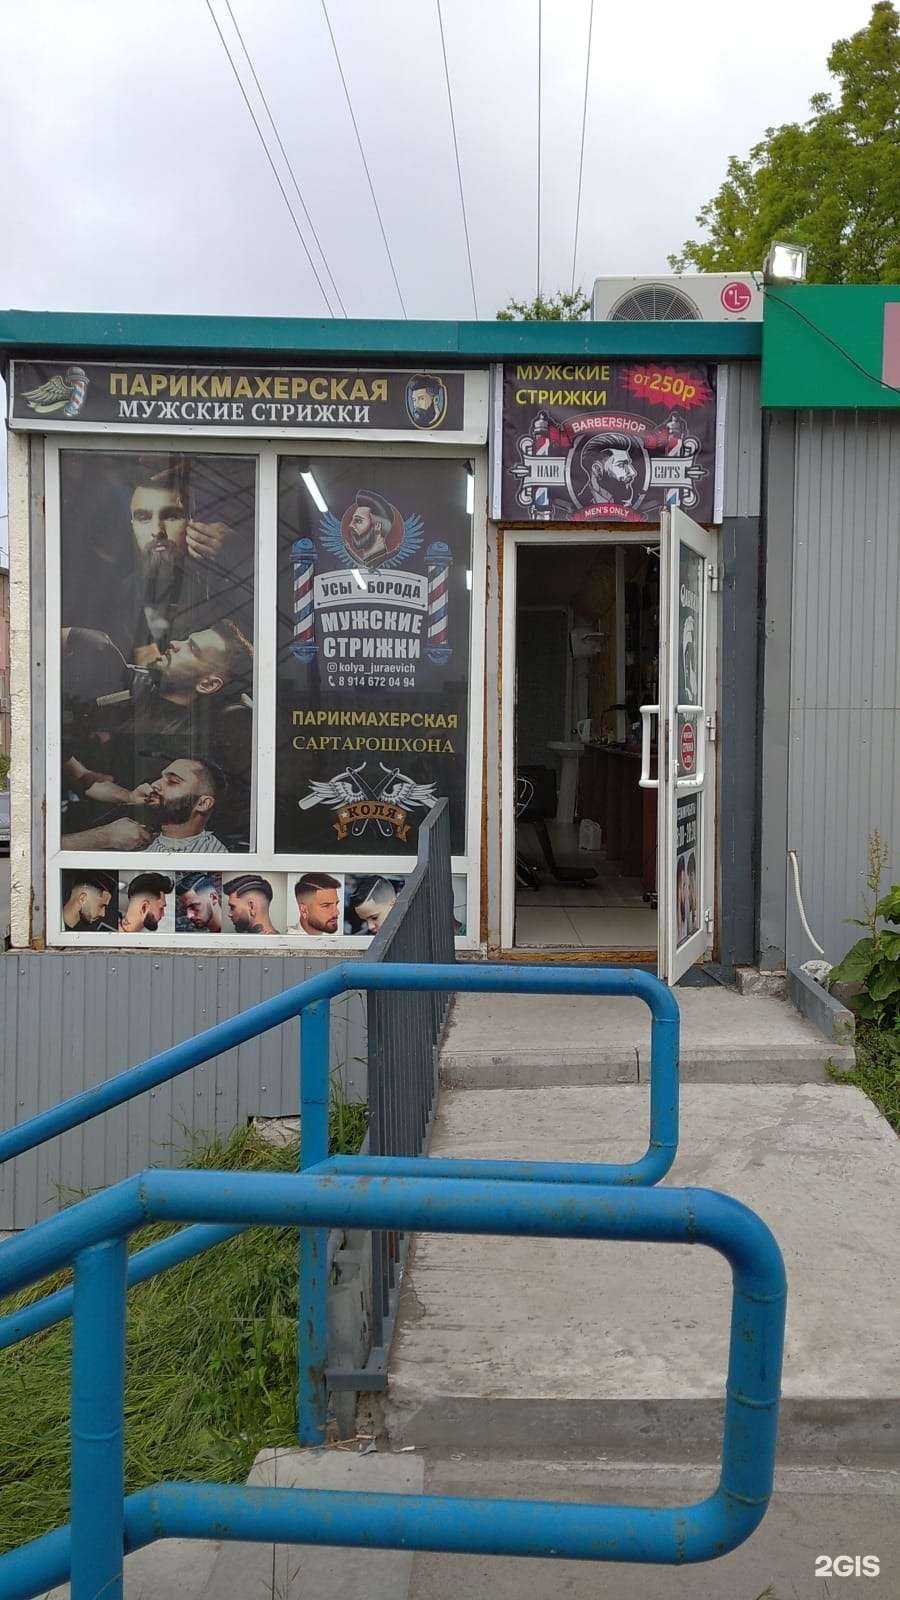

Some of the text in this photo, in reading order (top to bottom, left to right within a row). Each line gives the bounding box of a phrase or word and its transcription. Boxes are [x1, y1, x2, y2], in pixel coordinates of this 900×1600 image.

[516, 365, 610, 381] МУЖСКИЕ
[109, 373, 388, 401] ПАРИКМАХЕРСКАЯ
[515, 389, 607, 406] СТРИЖКИ
[118, 400, 370, 423] МУЖСКИЕ СТРИЖКИ
[572, 419, 646, 433] BARBERSHOP
[537, 465, 560, 478] HAIR
[584, 506, 629, 517] MEN'S ONLY
[321, 580, 420, 598] УСЫ БОРОДА
[321, 610, 423, 633] МУЖСКИЕ
[323, 637, 420, 658] СТРИЖКИ
[339, 661, 415, 675] kolya_juraevich
[338, 676, 415, 687] 8 914 672 04 94
[292, 711, 458, 728] ПАРИКМАХЕРСКАЯ
[292, 736, 455, 753] САРТАРОШХОНА
[347, 804, 397, 819] КОЛЯ
